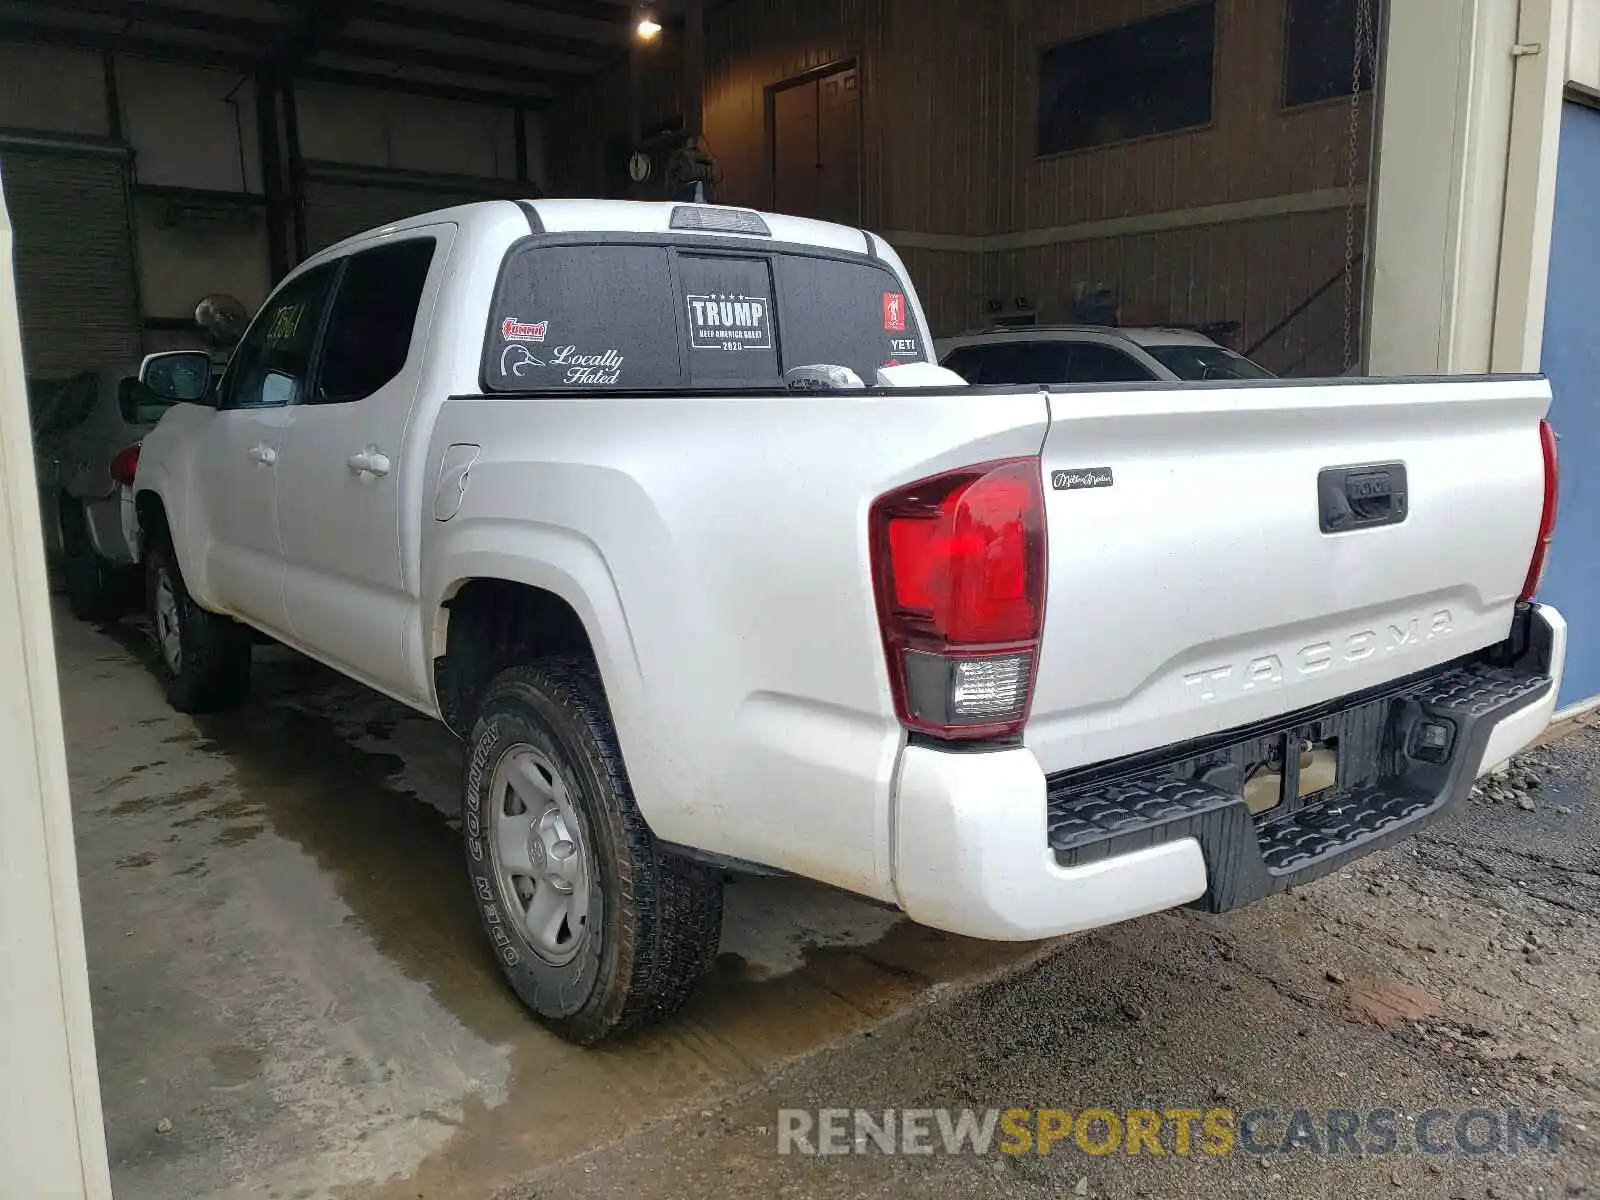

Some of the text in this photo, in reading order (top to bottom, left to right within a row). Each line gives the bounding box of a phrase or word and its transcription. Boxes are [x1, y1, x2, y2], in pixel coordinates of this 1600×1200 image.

[693, 301, 763, 326] TRUMP
[700, 330, 714, 338] KEEP
[716, 330, 743, 338] AMERICA
[891, 339, 915, 350] YETI
[723, 342, 742, 350] 2020
[549, 345, 624, 371] Locally
[564, 366, 621, 385] Hated
[1182, 609, 1453, 701] TACOMA
[466, 722, 520, 967] OPEN COUNTRY
